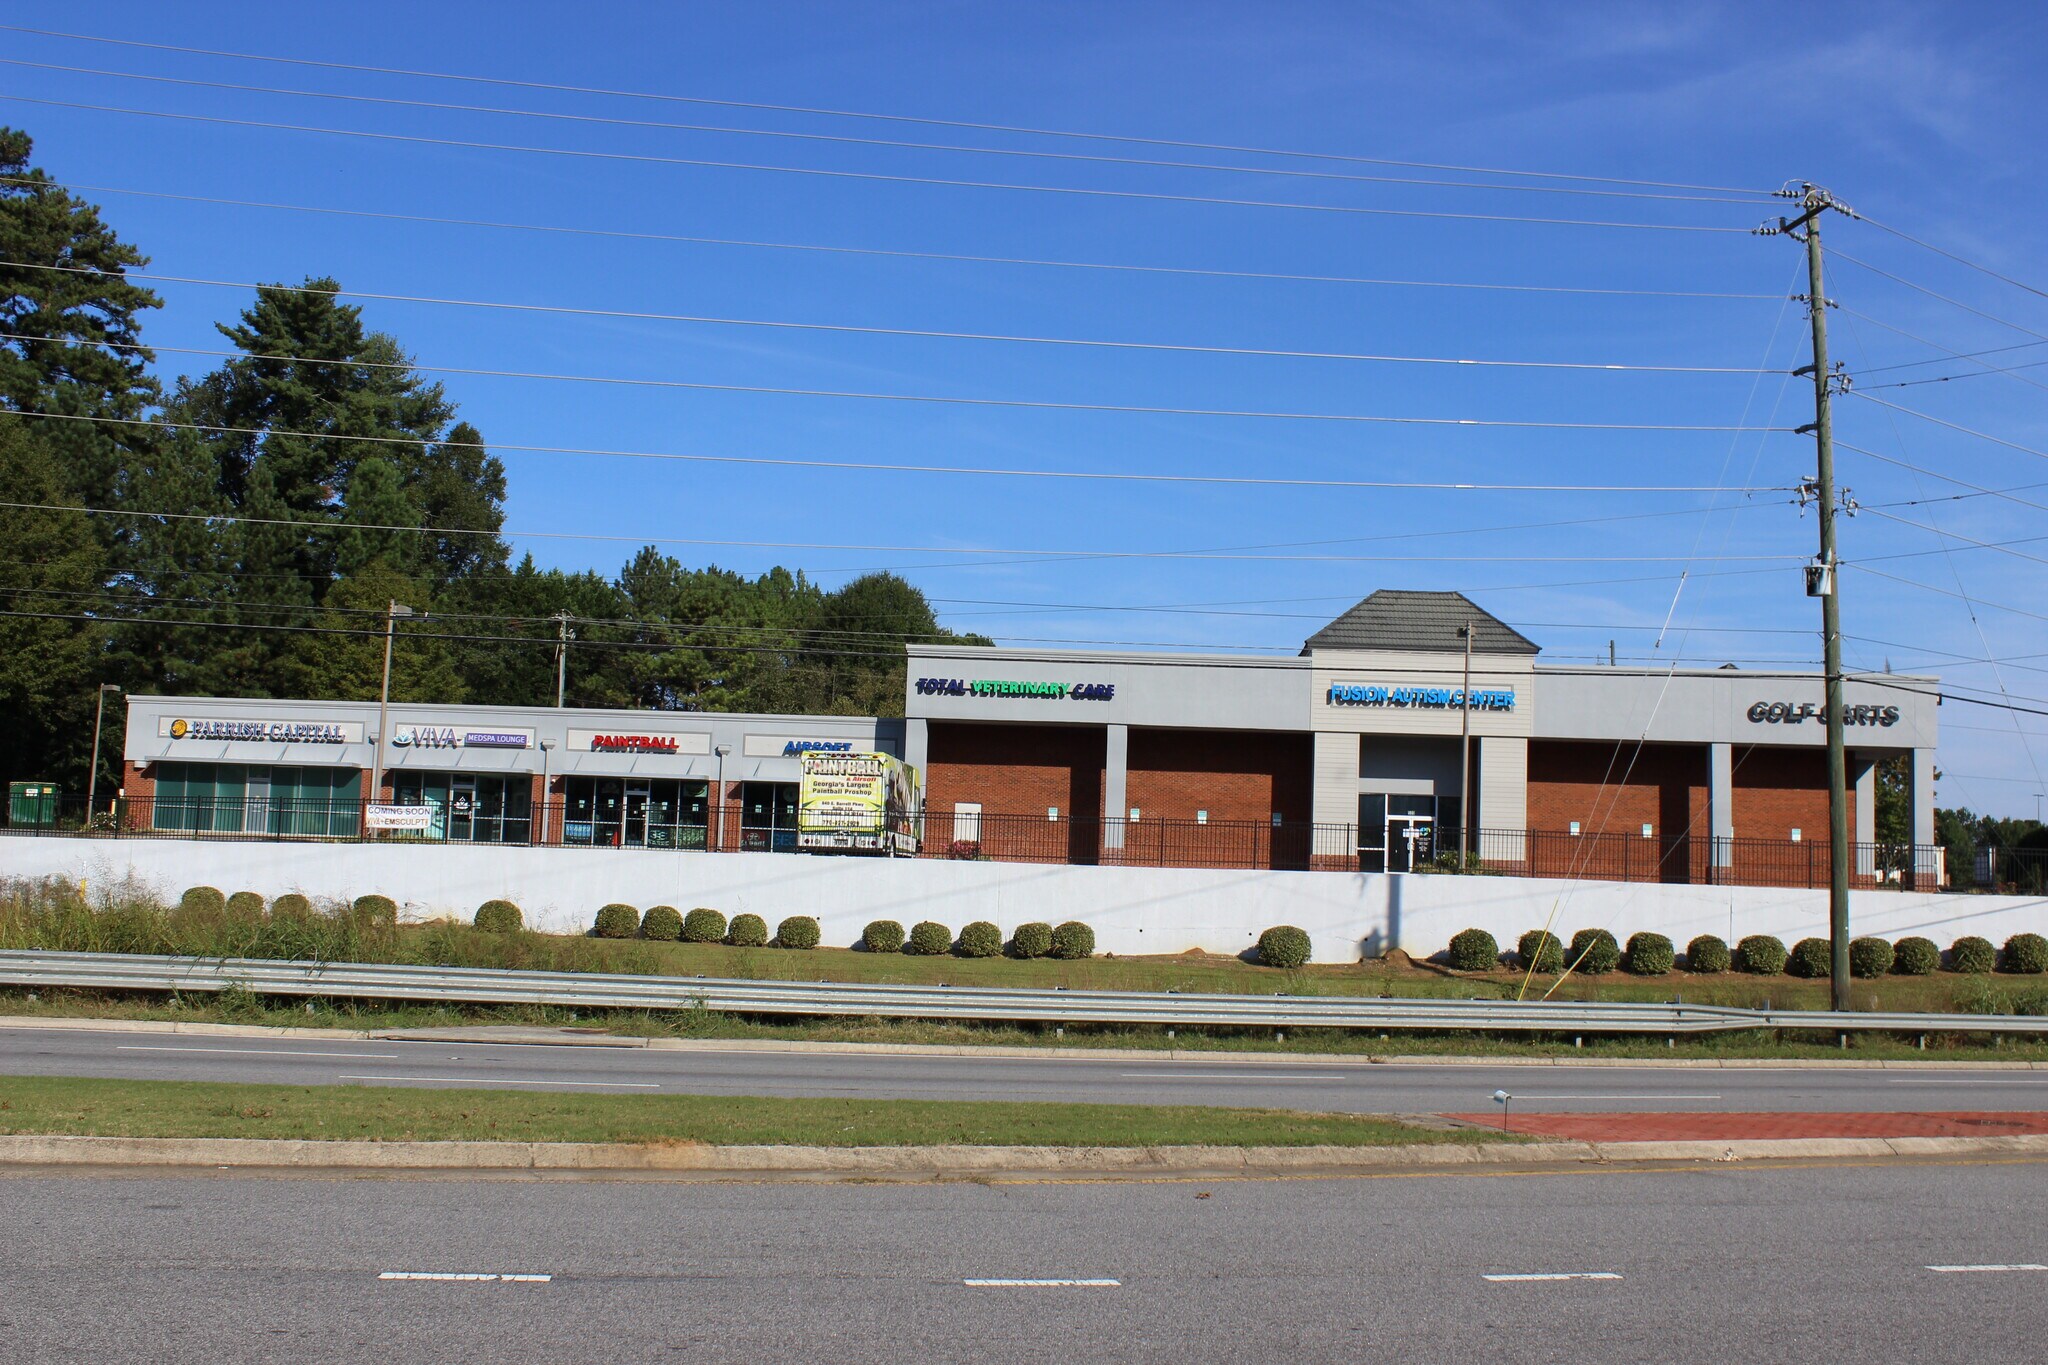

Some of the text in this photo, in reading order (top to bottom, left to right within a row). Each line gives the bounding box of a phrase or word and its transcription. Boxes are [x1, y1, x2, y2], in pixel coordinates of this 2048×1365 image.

[917, 677, 1116, 697] TOTAL VETERINARY CARE
[1331, 685, 1516, 707] FUSION AUTISM CENTER
[1752, 701, 1816, 720] GOLF
[191, 720, 346, 739] PARRISH CAPITAL
[413, 727, 458, 746] VIVA
[468, 734, 526, 744] MEDSPA LOUNGE
[594, 734, 680, 749] PAINTBALL
[785, 740, 853, 752] AIRSOFT
[805, 759, 882, 776] PAINTBALL
[812, 780, 872, 789] Georgia's Largest
[844, 788, 872, 796] Proshop
[368, 806, 431, 816] COMING SOON
